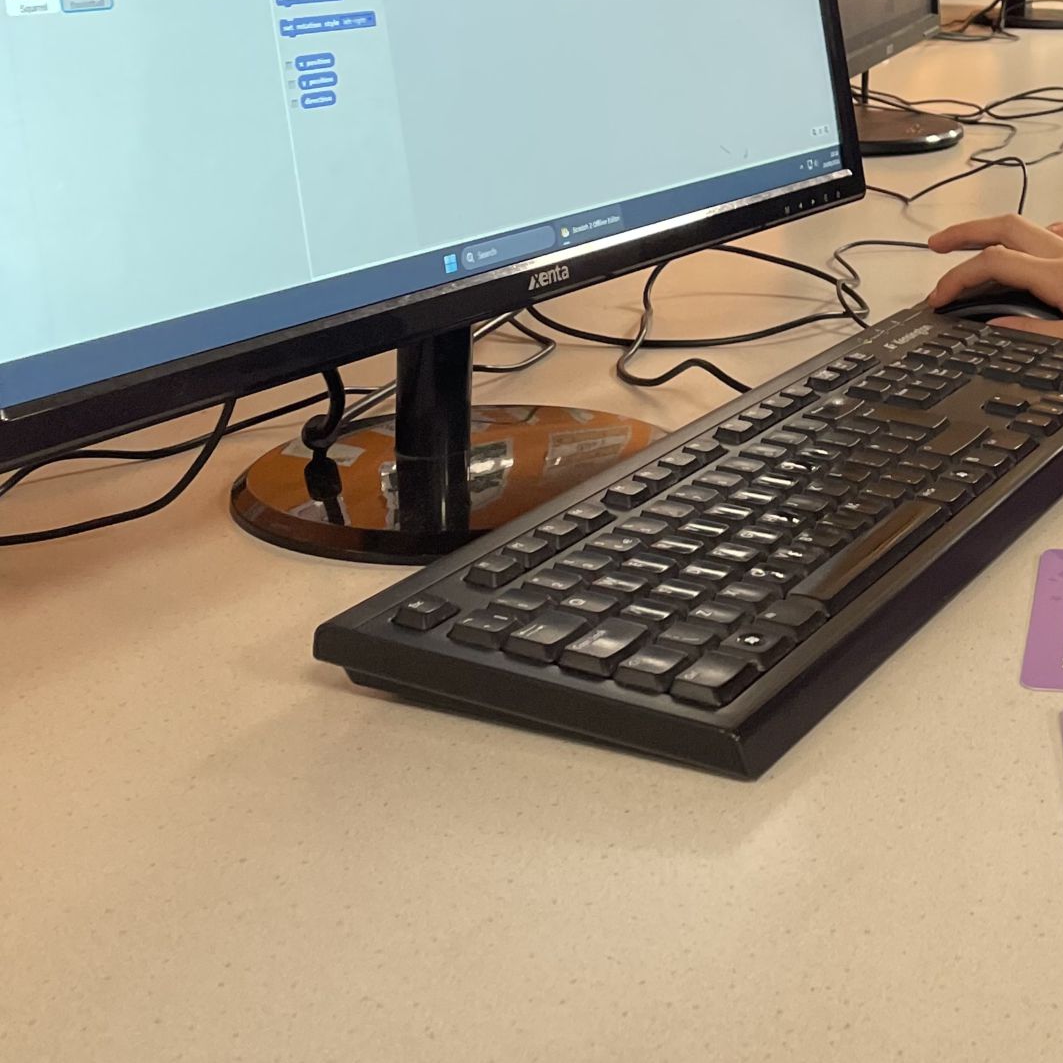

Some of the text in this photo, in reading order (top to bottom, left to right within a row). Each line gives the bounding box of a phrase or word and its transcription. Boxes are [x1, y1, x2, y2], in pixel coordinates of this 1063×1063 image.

[476, 247, 498, 260] Search
[569, 598, 586, 607] Q
[695, 609, 712, 618] Z
